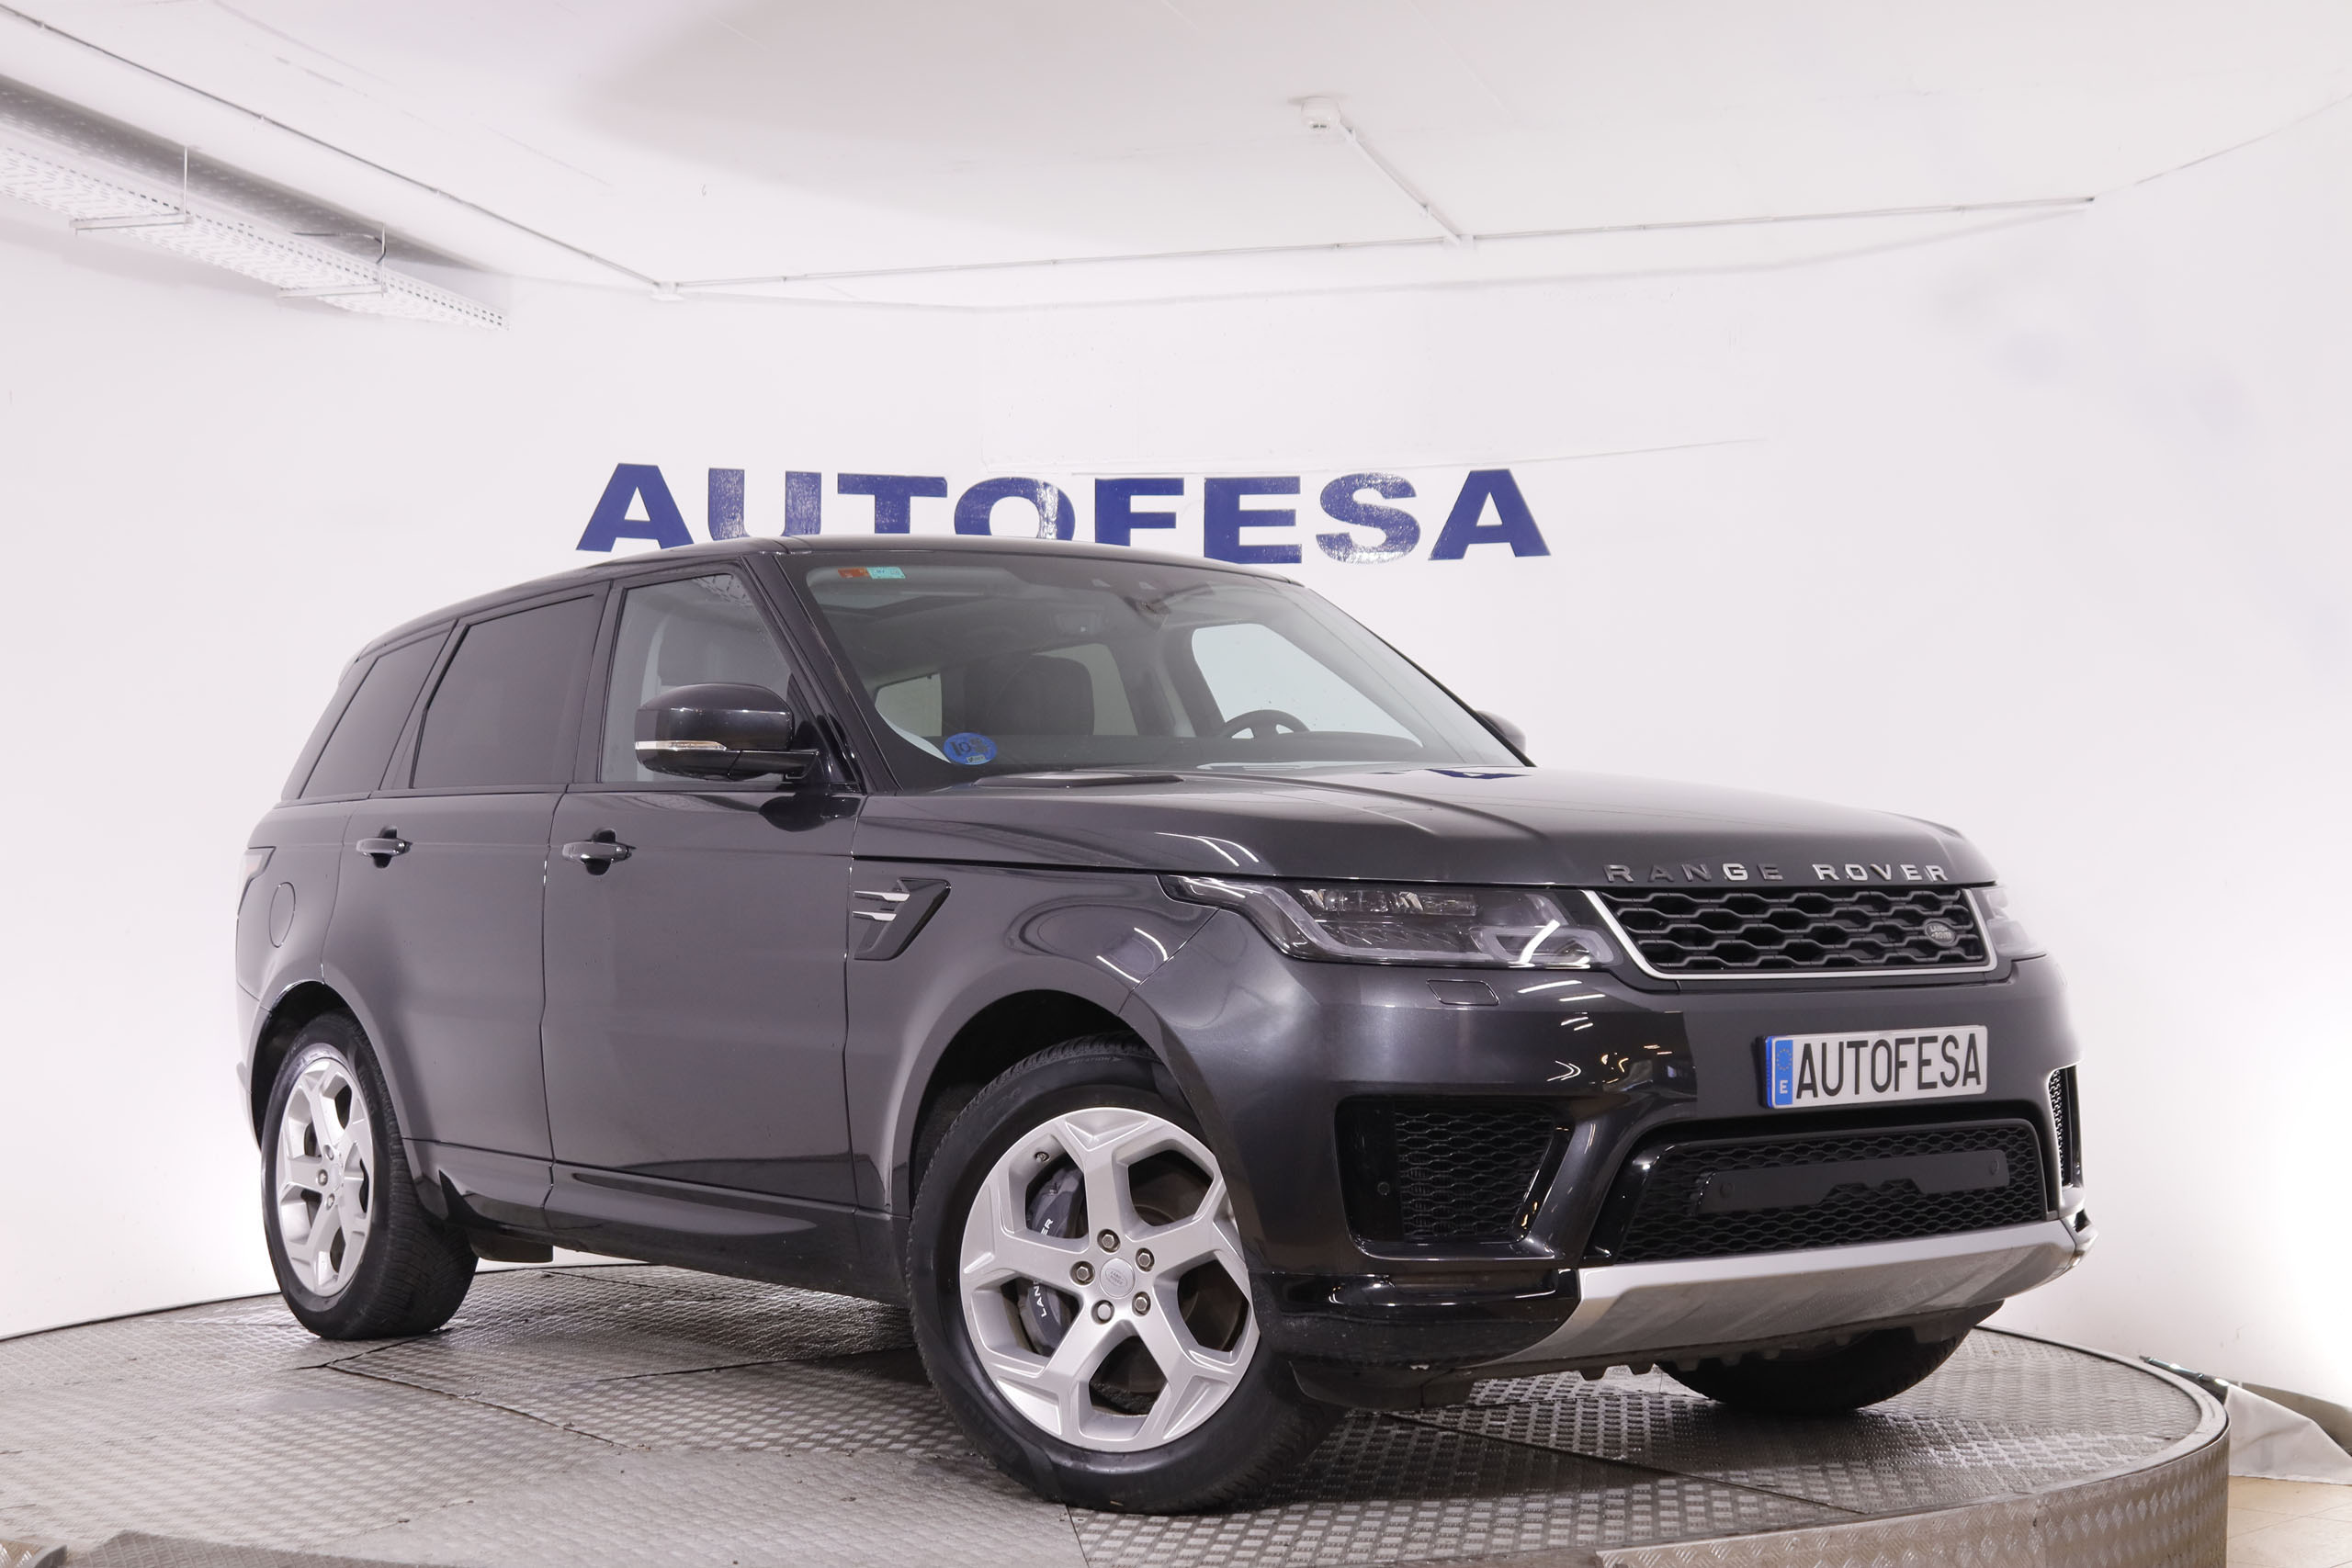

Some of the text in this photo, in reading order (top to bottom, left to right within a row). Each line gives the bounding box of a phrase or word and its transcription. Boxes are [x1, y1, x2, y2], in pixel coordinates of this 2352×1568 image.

[576, 463, 1551, 564] AUTOFESA
[1603, 863, 1949, 883] RANGE ROVER
[1779, 1079, 1789, 1094] E
[1796, 1032, 1982, 1100] AUTOFESA
